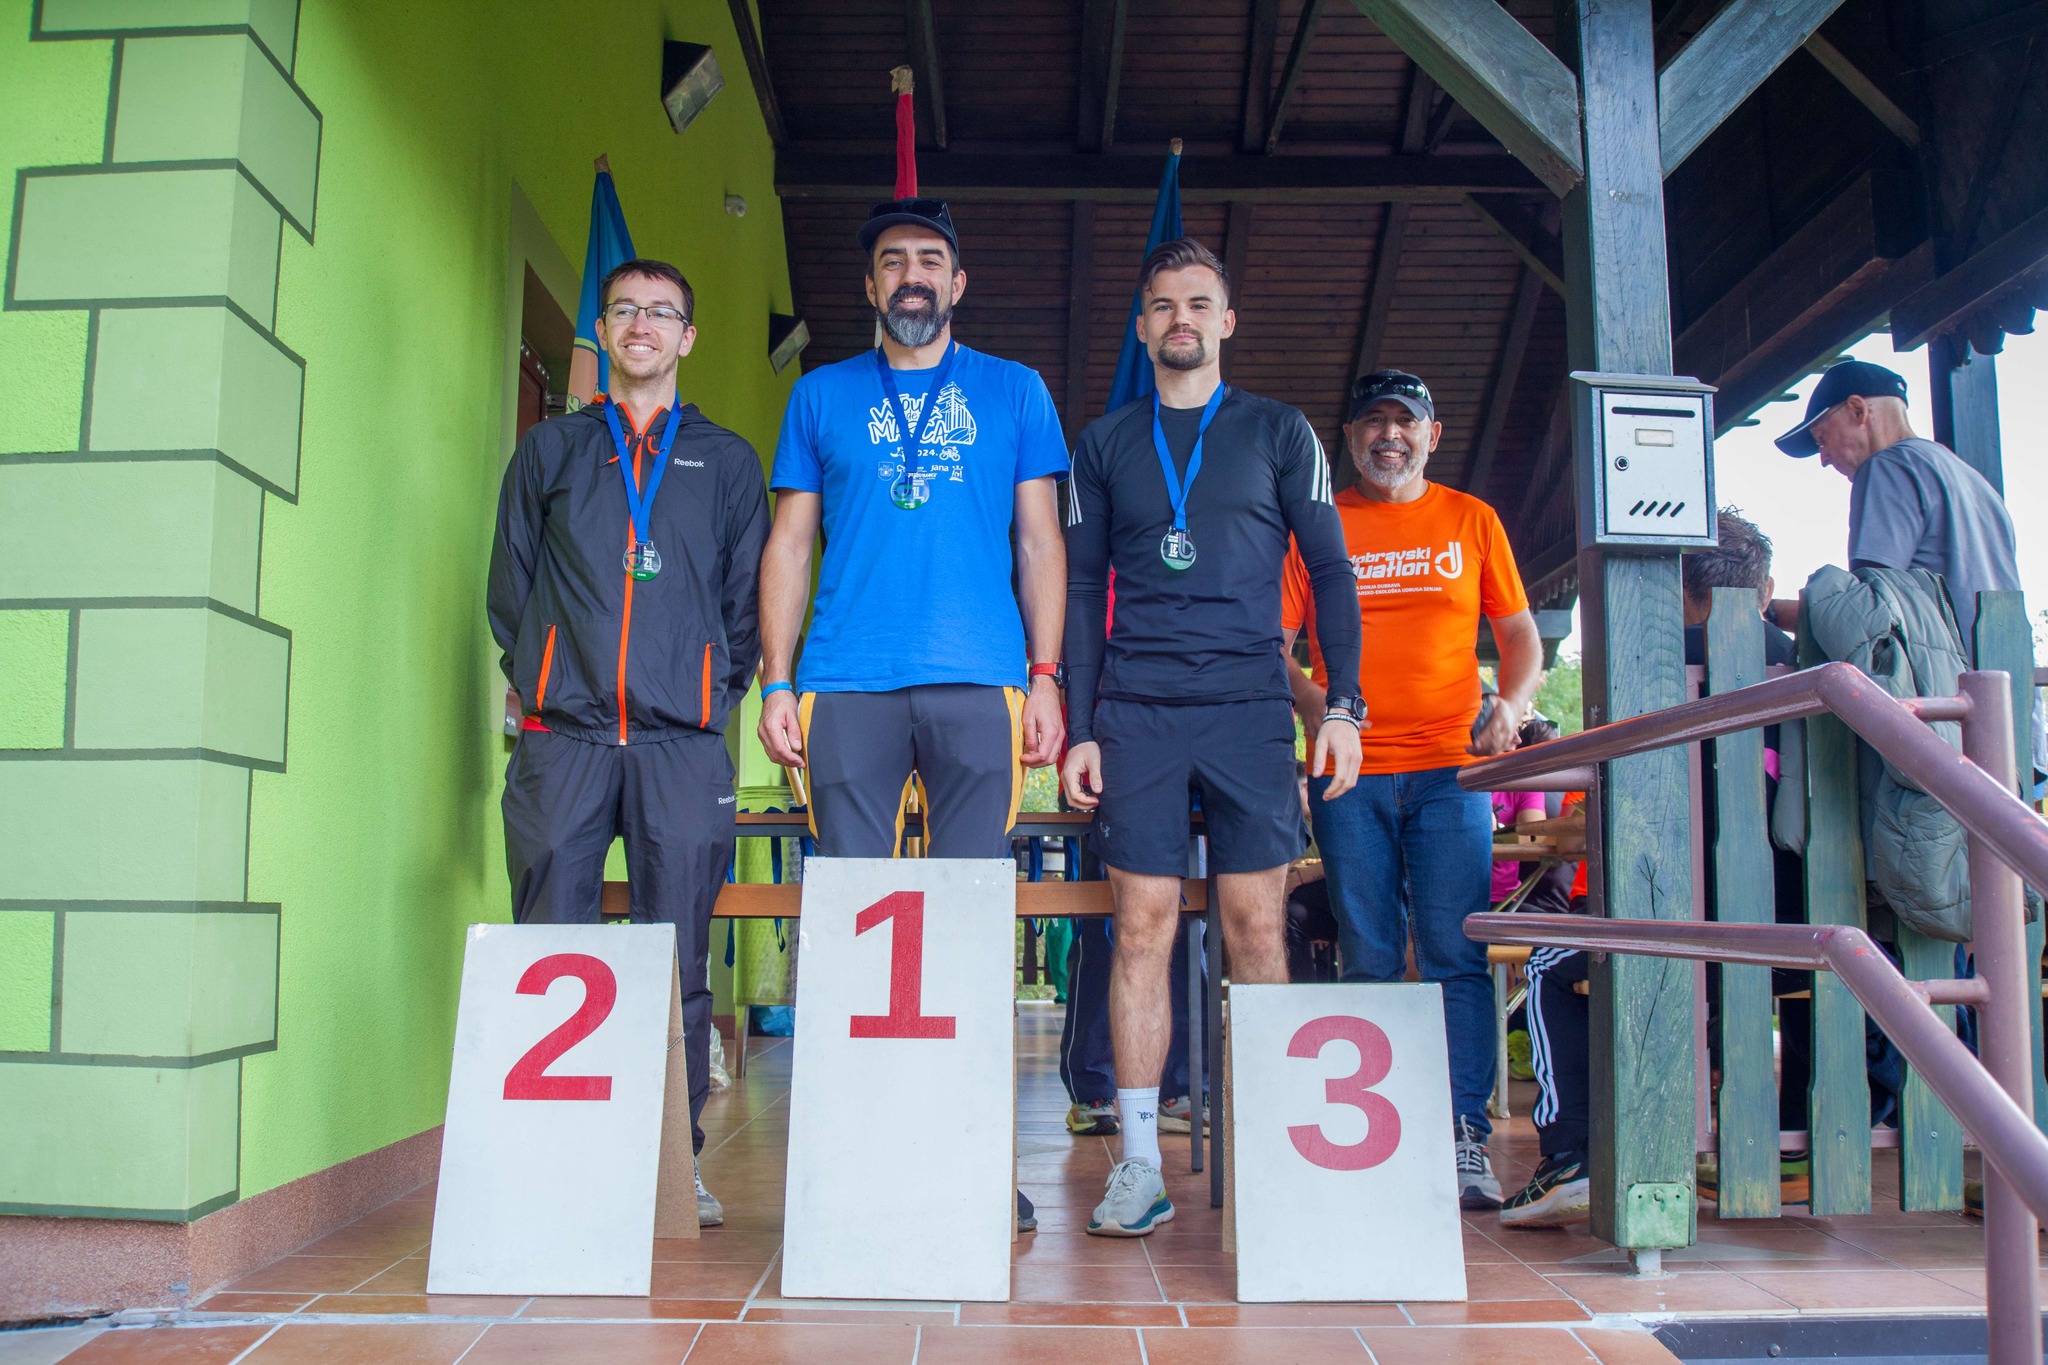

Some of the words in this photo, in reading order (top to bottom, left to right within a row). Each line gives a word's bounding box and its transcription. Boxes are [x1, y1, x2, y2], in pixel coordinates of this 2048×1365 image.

[674, 458, 705, 468] Reebok
[906, 411, 918, 421] de
[503, 953, 617, 1101] 2
[849, 891, 956, 1039] 1
[1286, 1015, 1401, 1171] 3
